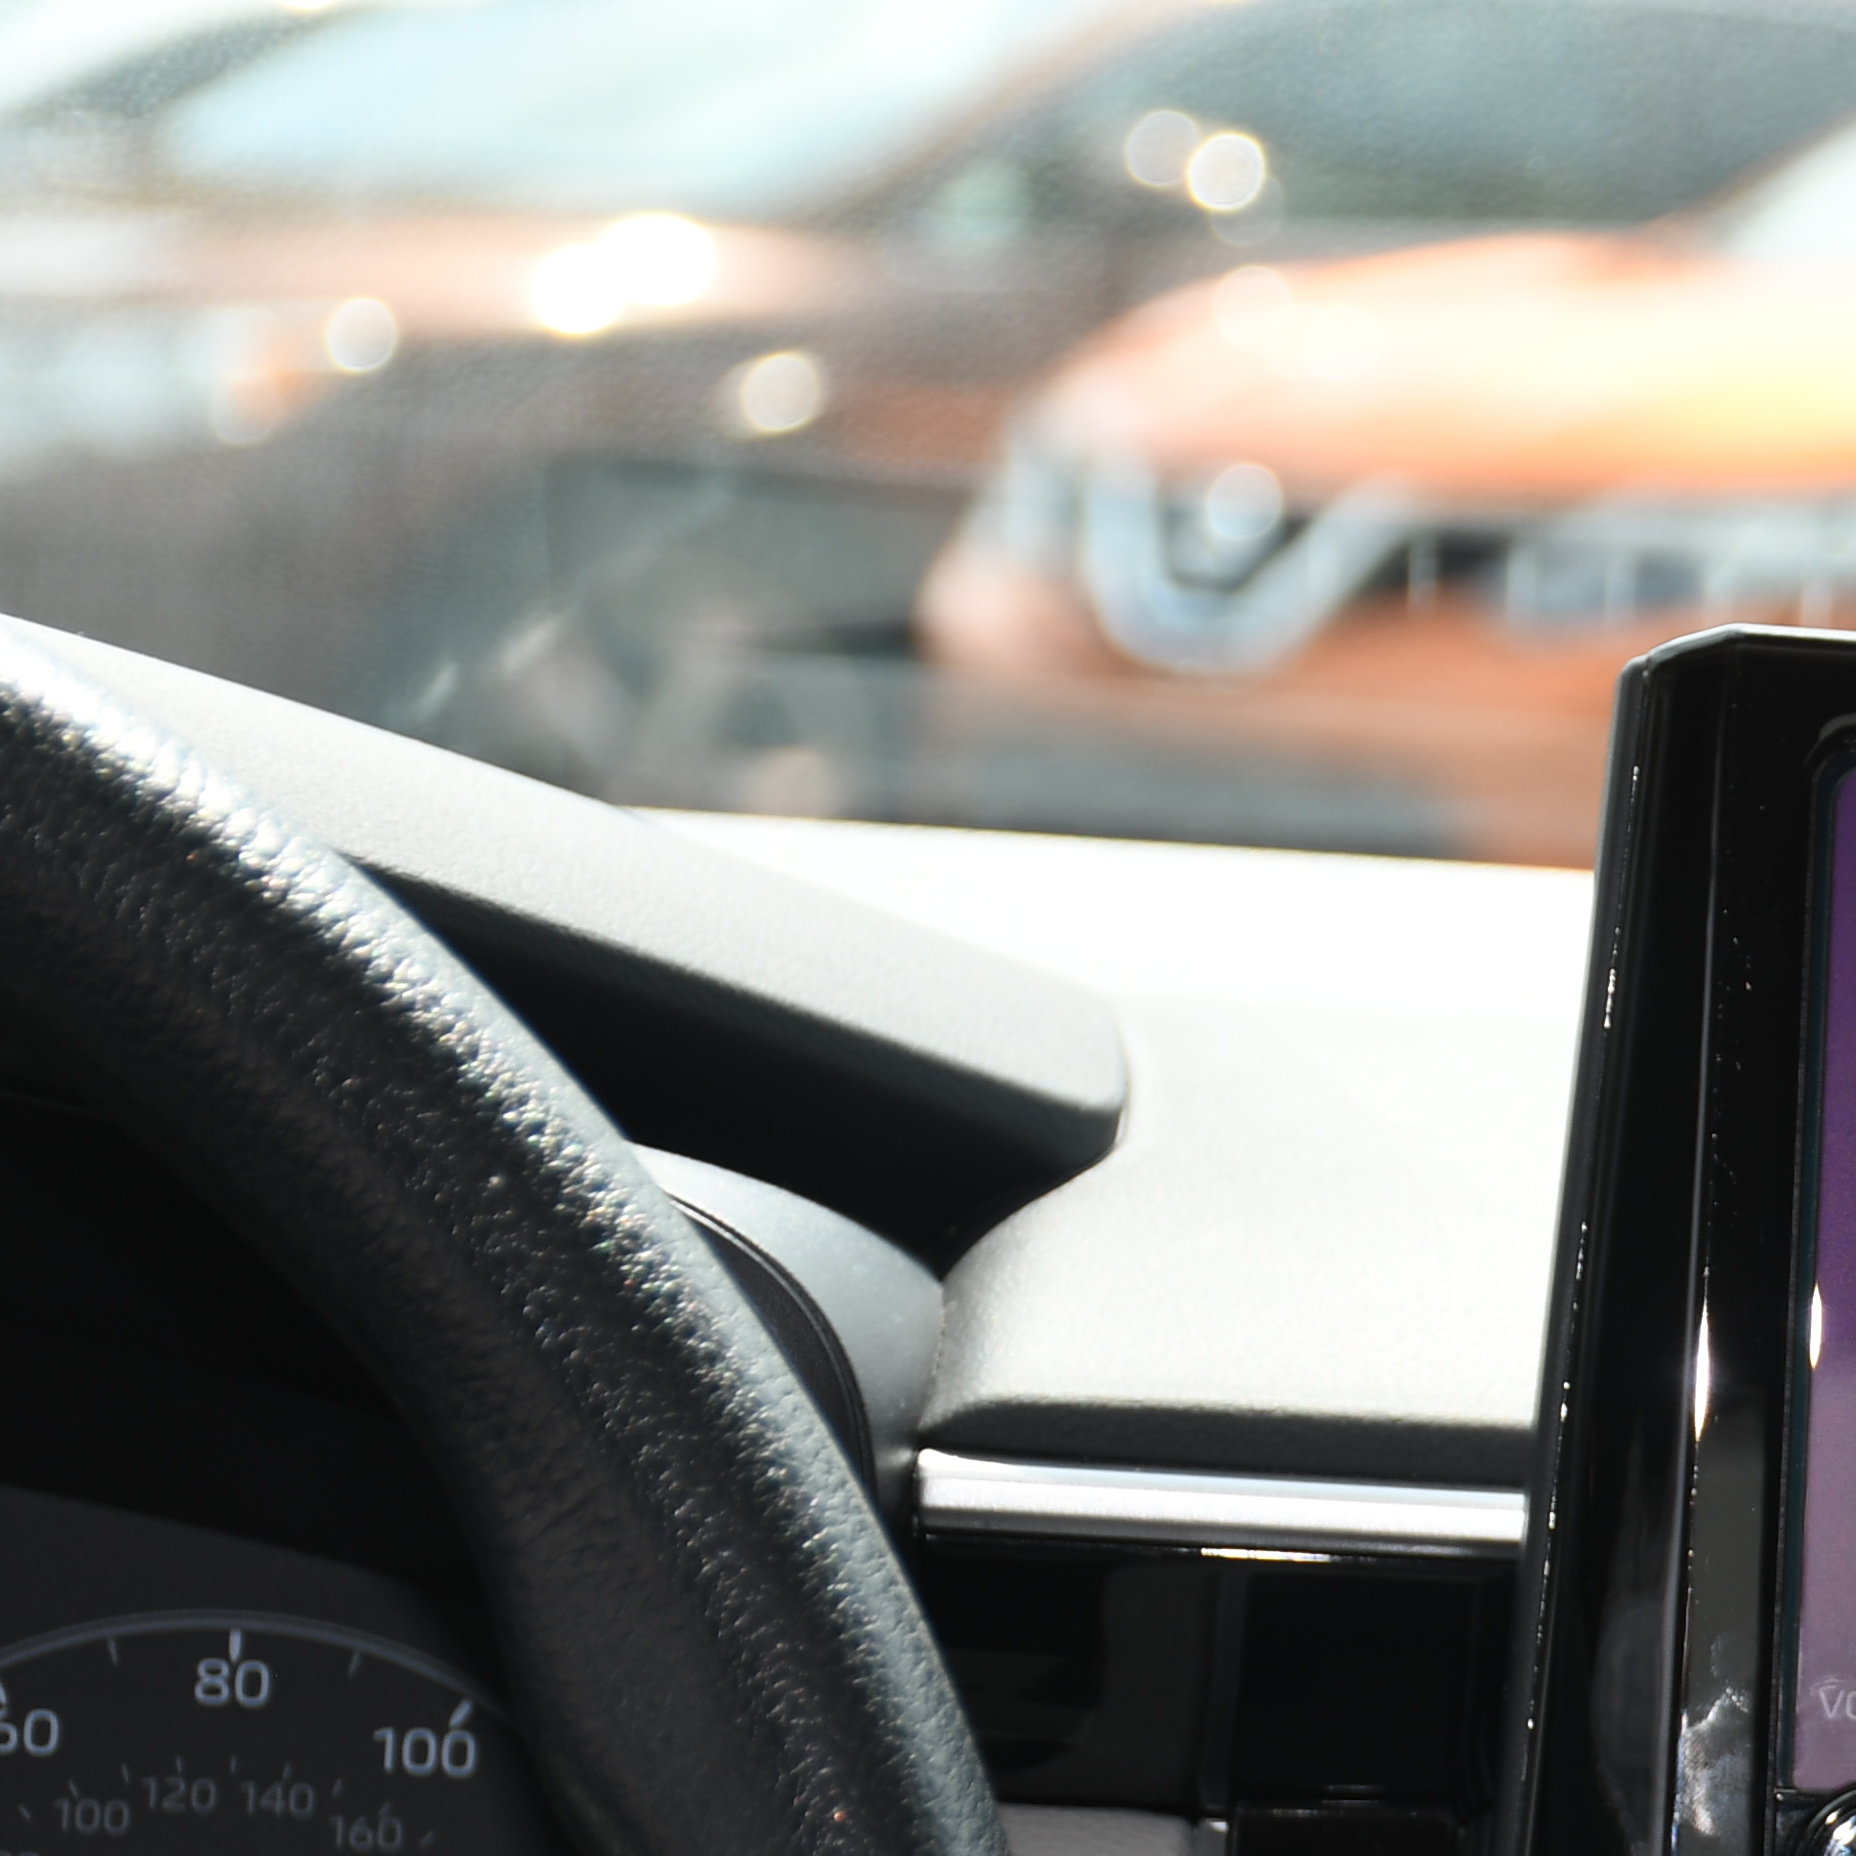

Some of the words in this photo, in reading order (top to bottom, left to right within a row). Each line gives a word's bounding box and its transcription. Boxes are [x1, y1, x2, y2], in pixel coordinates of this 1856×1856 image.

[194, 1658, 271, 1708] 80
[373, 1726, 477, 1777] 100
[142, 1777, 217, 1816] 120
[240, 1780, 316, 1819] 140
[56, 1798, 130, 1836] 100
[329, 1814, 404, 1852] 160
